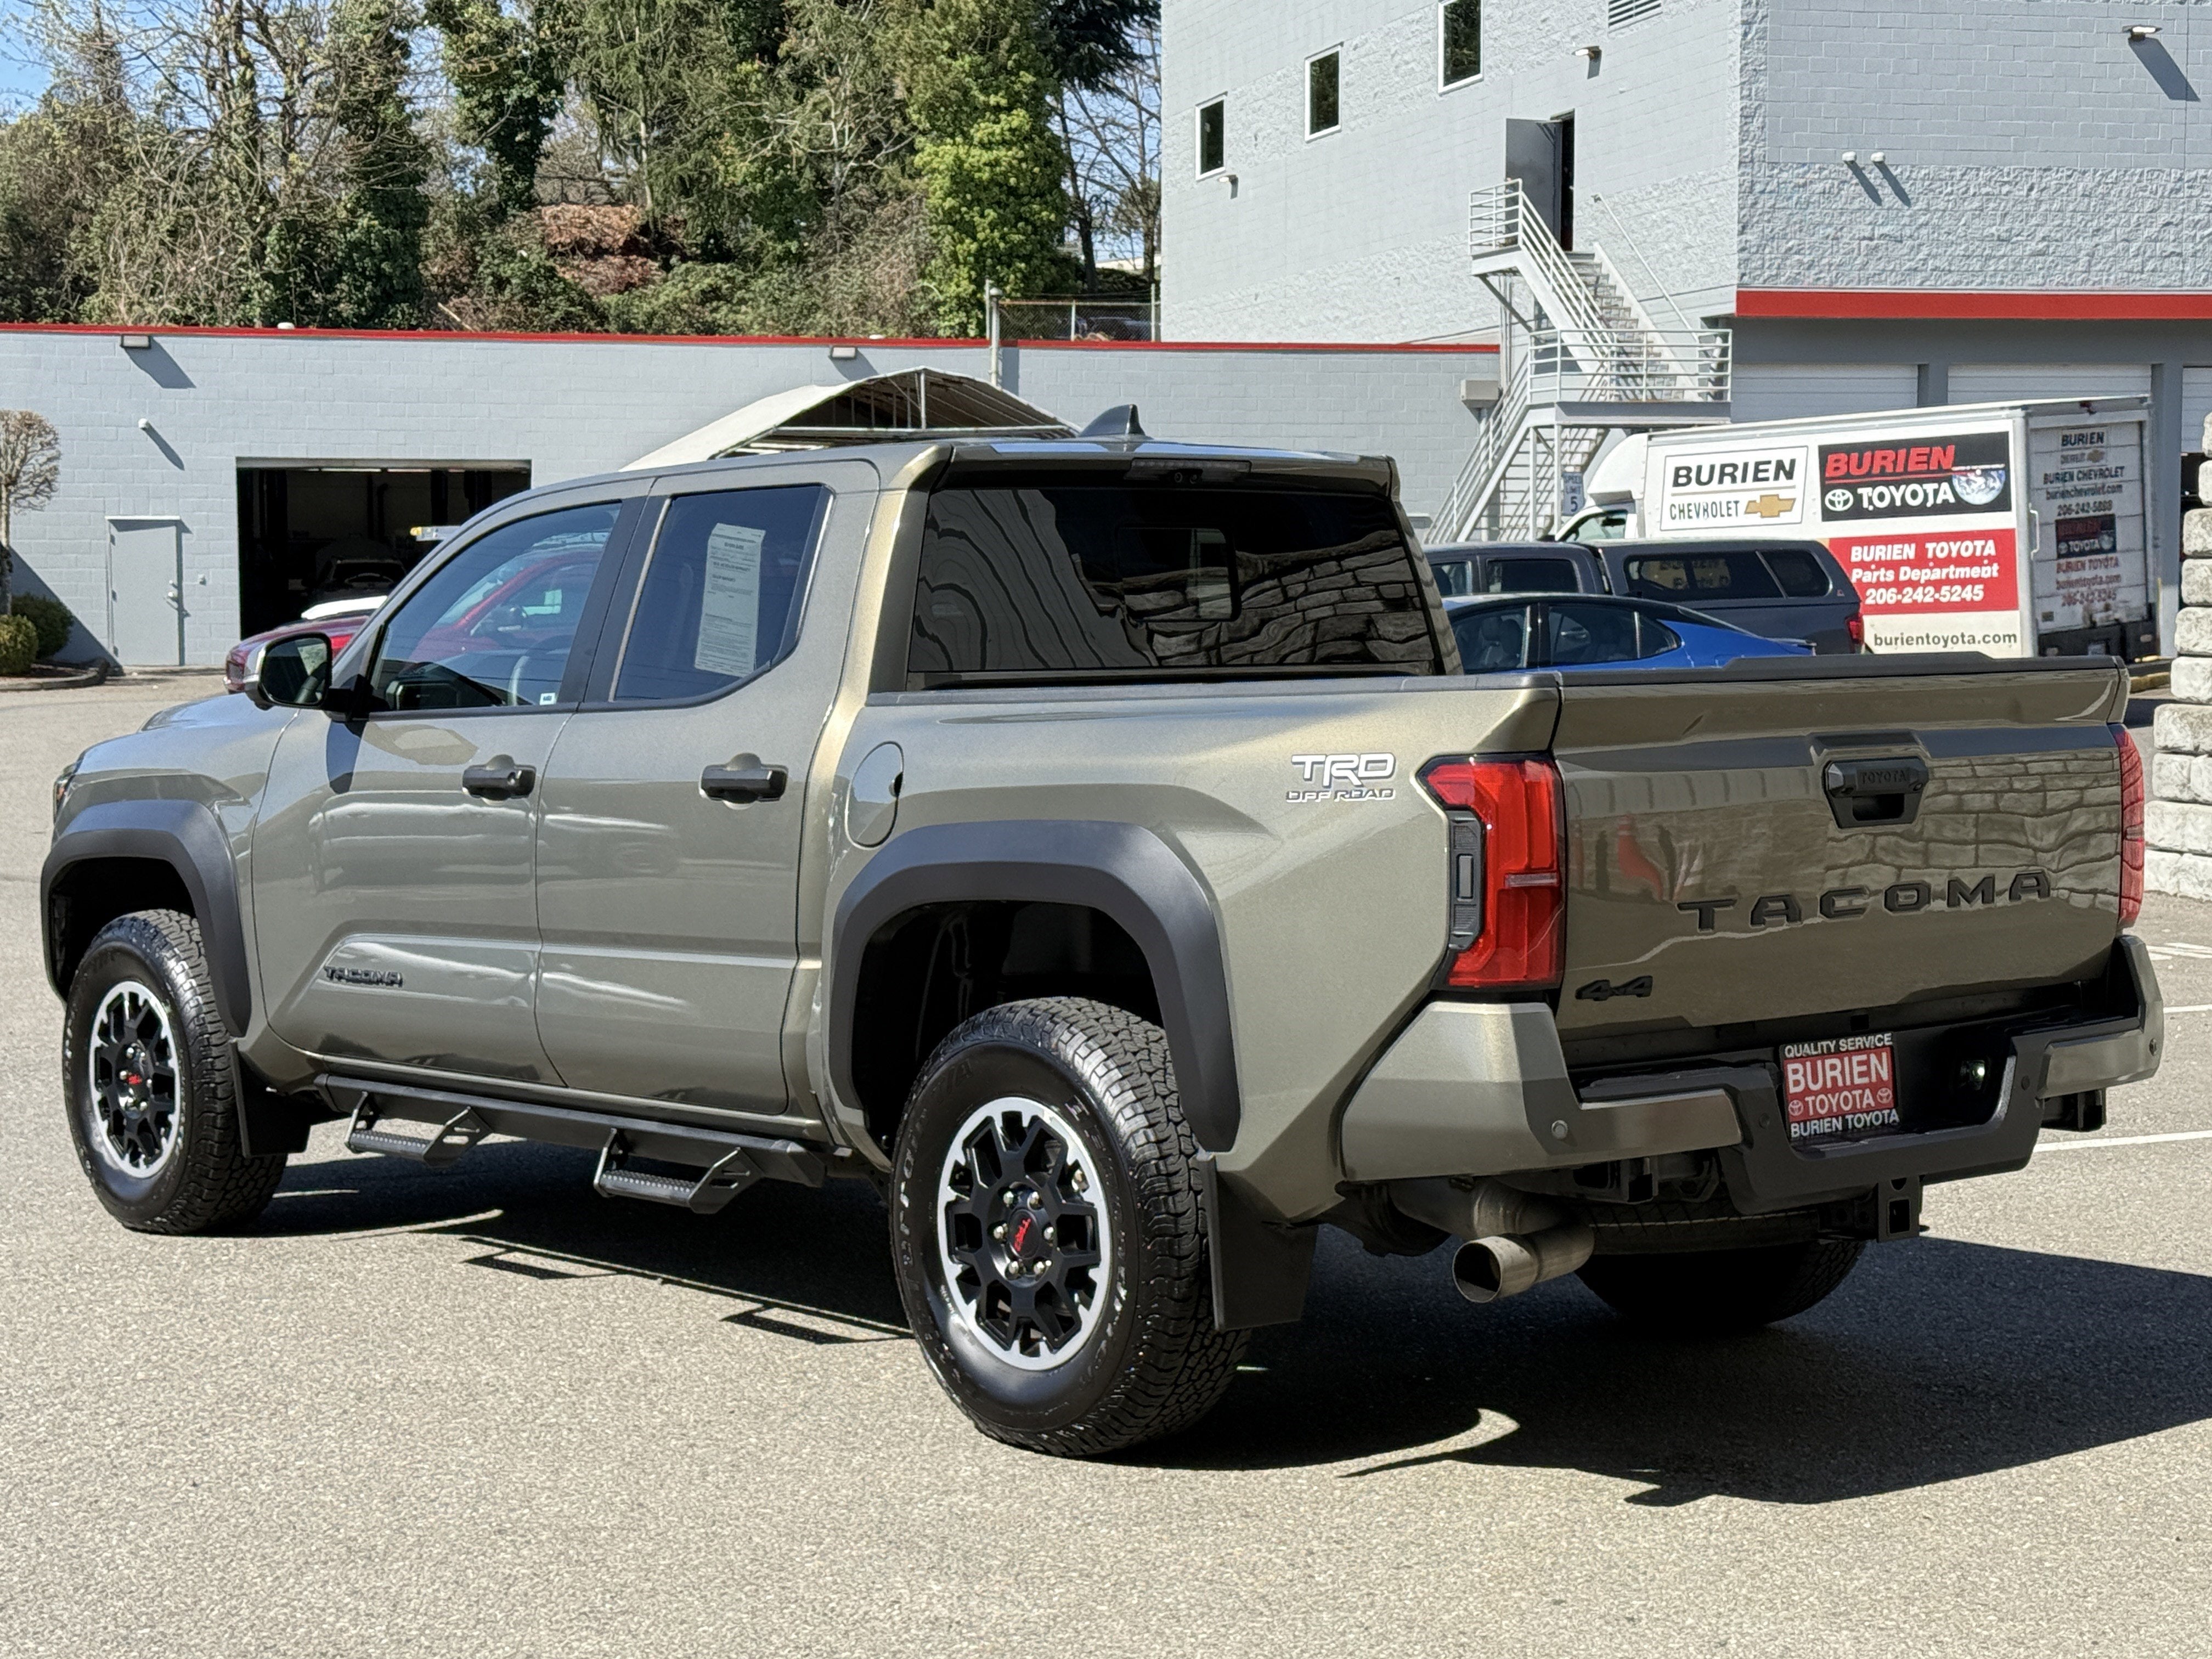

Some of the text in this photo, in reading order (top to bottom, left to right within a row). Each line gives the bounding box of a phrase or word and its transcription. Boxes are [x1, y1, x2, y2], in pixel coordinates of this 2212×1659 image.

[2061, 431, 2104, 446] BURIEN
[1825, 444, 1955, 477] BURIEN
[1672, 459, 1796, 487] BURIEN
[2044, 471, 2074, 484] BURIEN
[1571, 496, 1578, 512] 5
[1858, 482, 1955, 509] TOYOTA
[1669, 500, 1740, 520] CHEVROLET
[1850, 540, 1996, 562] BURIEN TOYOTA
[1852, 563, 1999, 583] Parts Department
[1866, 585, 1984, 605] 206-242-5245
[1874, 633, 2017, 648] burientoyota.com
[1291, 753, 1396, 788] TRD
[1861, 770, 1908, 784] TOYOTA
[1286, 788, 1396, 803] OFF ROAD
[1676, 870, 2051, 931] TACOMA
[324, 965, 403, 988] TACOMA
[1785, 1033, 1893, 1058] QUALITY SERVICE
[1787, 1052, 1889, 1094] BURIEN
[1804, 1088, 1875, 1116] TOYOTA
[1791, 1109, 1900, 1138] BURIEN TOYOTA
